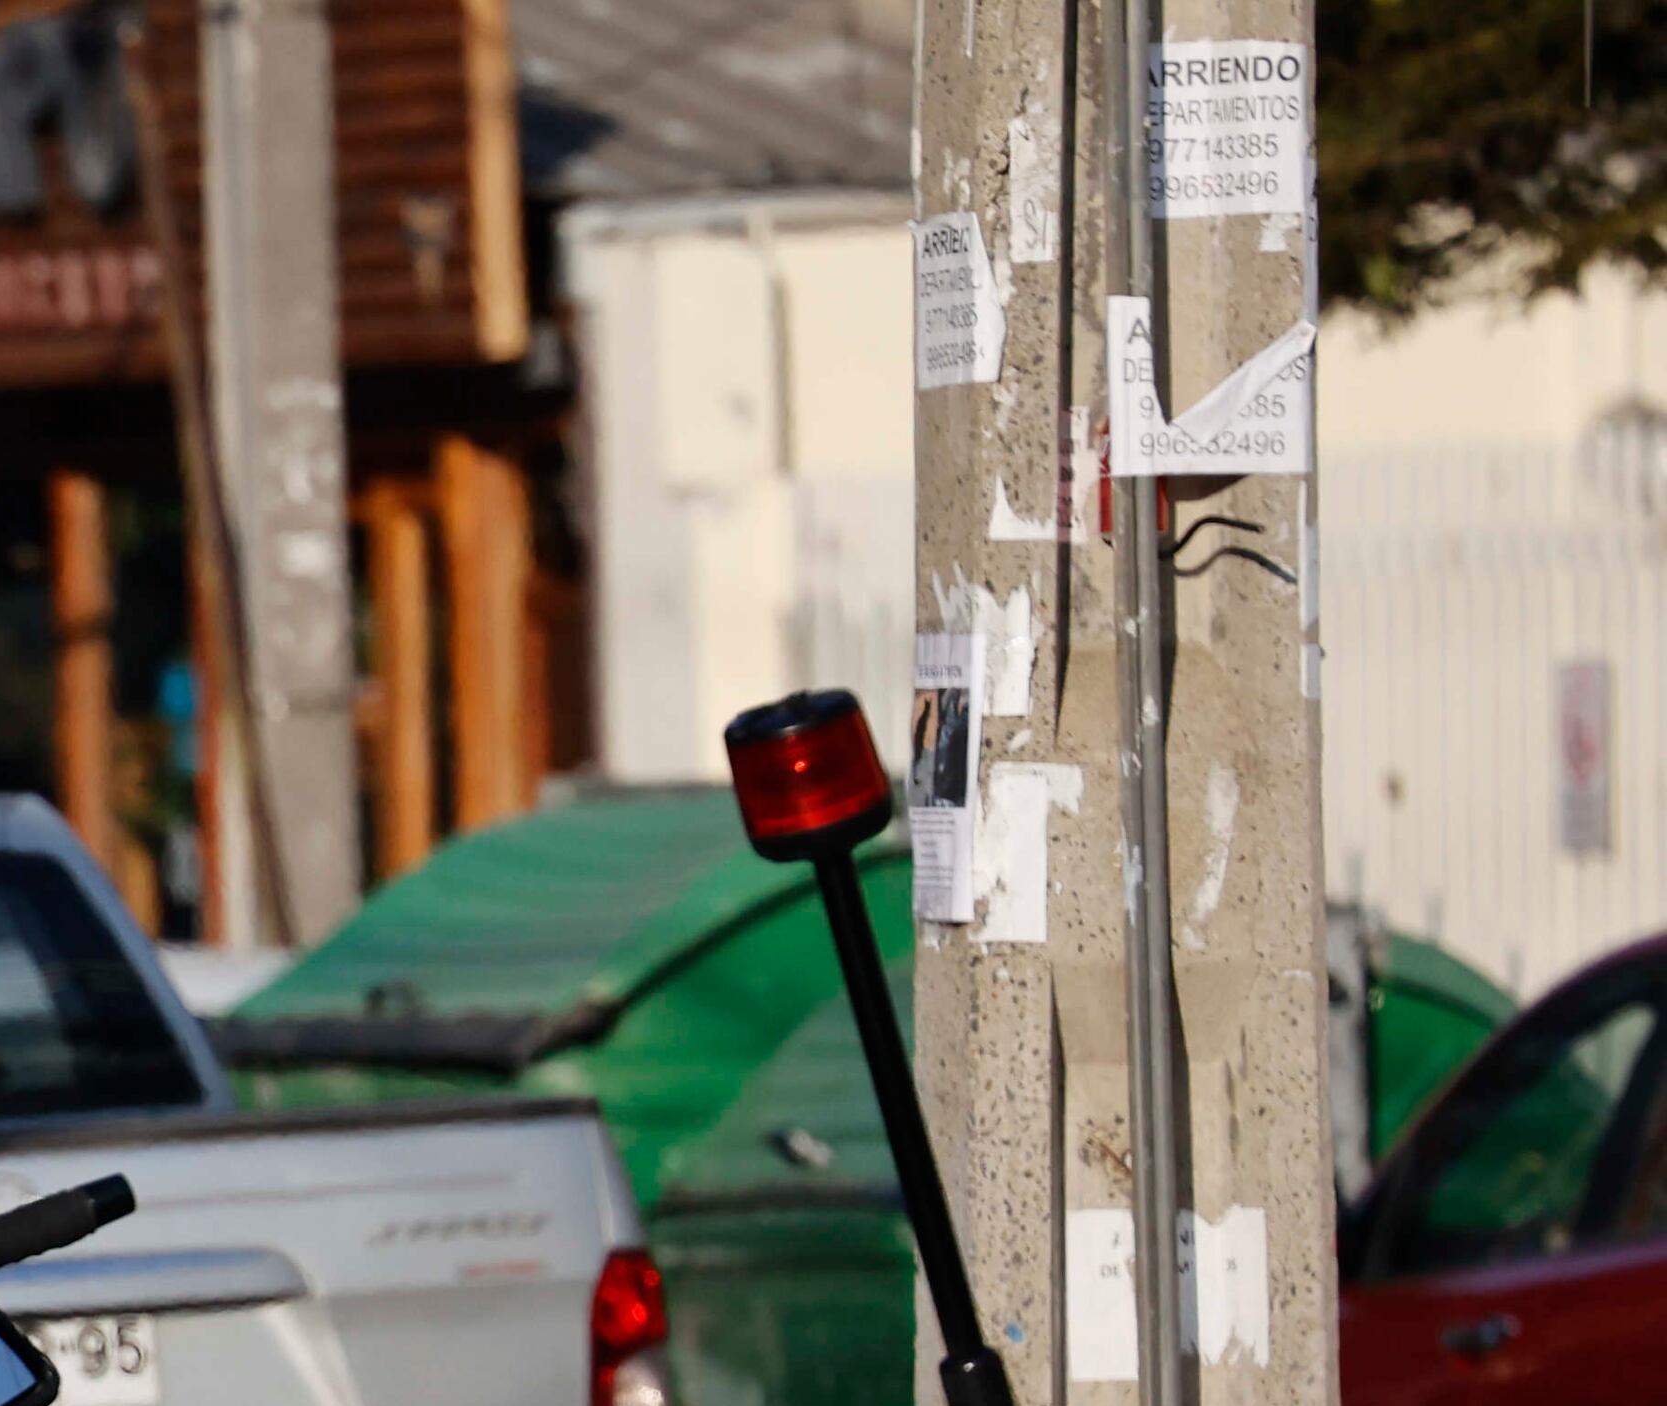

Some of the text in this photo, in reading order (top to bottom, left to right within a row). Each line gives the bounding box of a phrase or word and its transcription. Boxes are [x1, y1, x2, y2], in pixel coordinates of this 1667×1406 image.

[1148, 94, 1301, 126] EPARTAMENTOS
[1148, 132, 1280, 165] 977143385
[1149, 170, 1279, 201] 996532496
